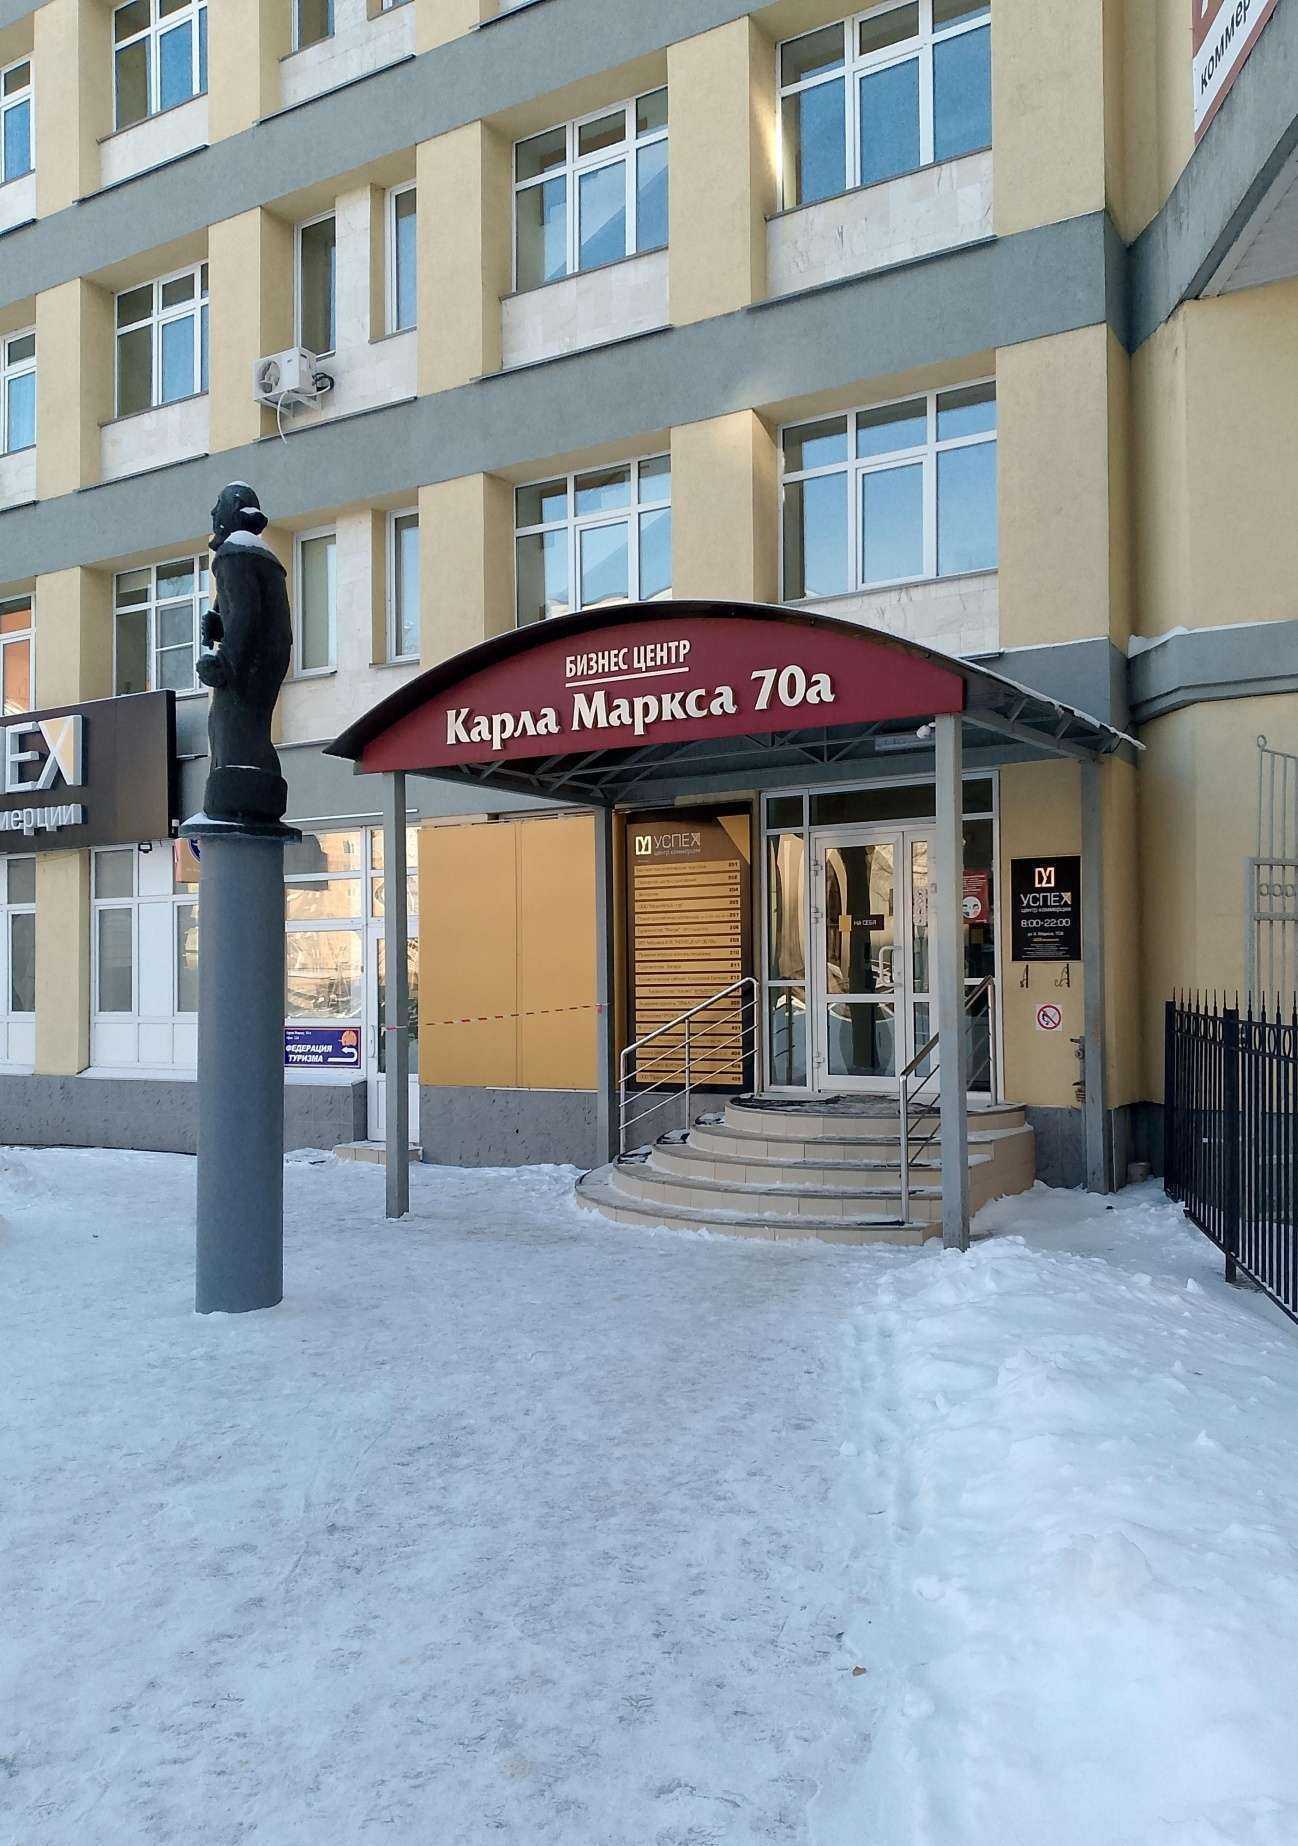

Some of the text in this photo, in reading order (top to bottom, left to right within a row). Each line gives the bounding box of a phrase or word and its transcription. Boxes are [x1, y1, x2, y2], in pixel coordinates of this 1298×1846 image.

[565, 639, 691, 678] БИЗНЕС ЦЕНТР
[446, 664, 836, 750] Карла Маркса 70а
[0, 714, 83, 795] ЕХ
[653, 832, 701, 849] УСПЕХ
[1020, 891, 1072, 907] УСПЕХ
[286, 1045, 332, 1053] ФЕДЕРАЦИЯ
[289, 1055, 323, 1063] ТУРИЗМА
